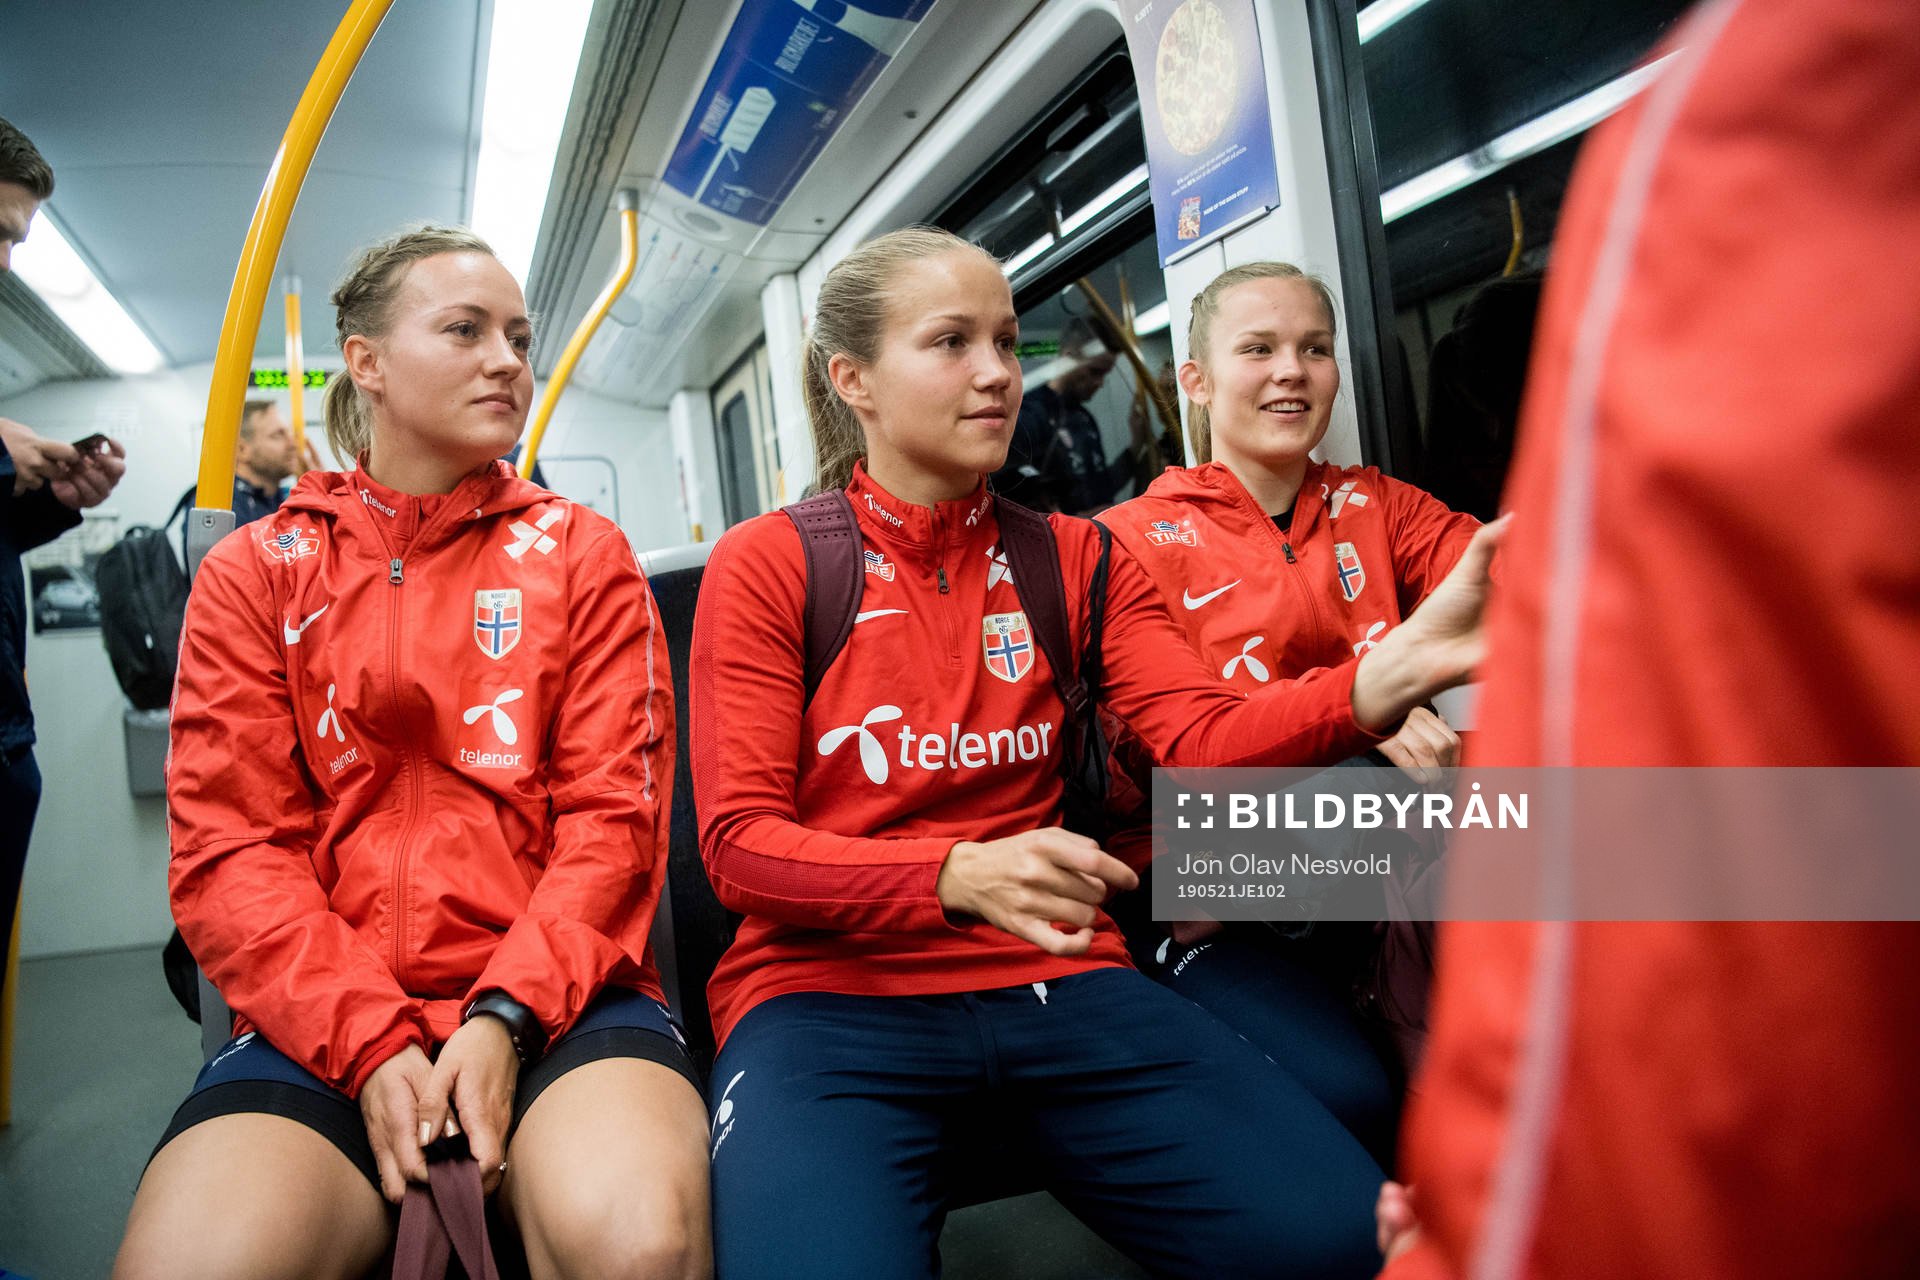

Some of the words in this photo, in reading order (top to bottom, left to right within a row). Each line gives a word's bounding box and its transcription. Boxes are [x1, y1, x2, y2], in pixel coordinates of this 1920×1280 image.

[368, 494, 397, 518] telenor
[872, 499, 904, 528] telenor
[1152, 532, 1192, 544] TINE
[459, 746, 522, 766] telenor
[897, 722, 1052, 771] telenor
[330, 747, 359, 775] telenor
